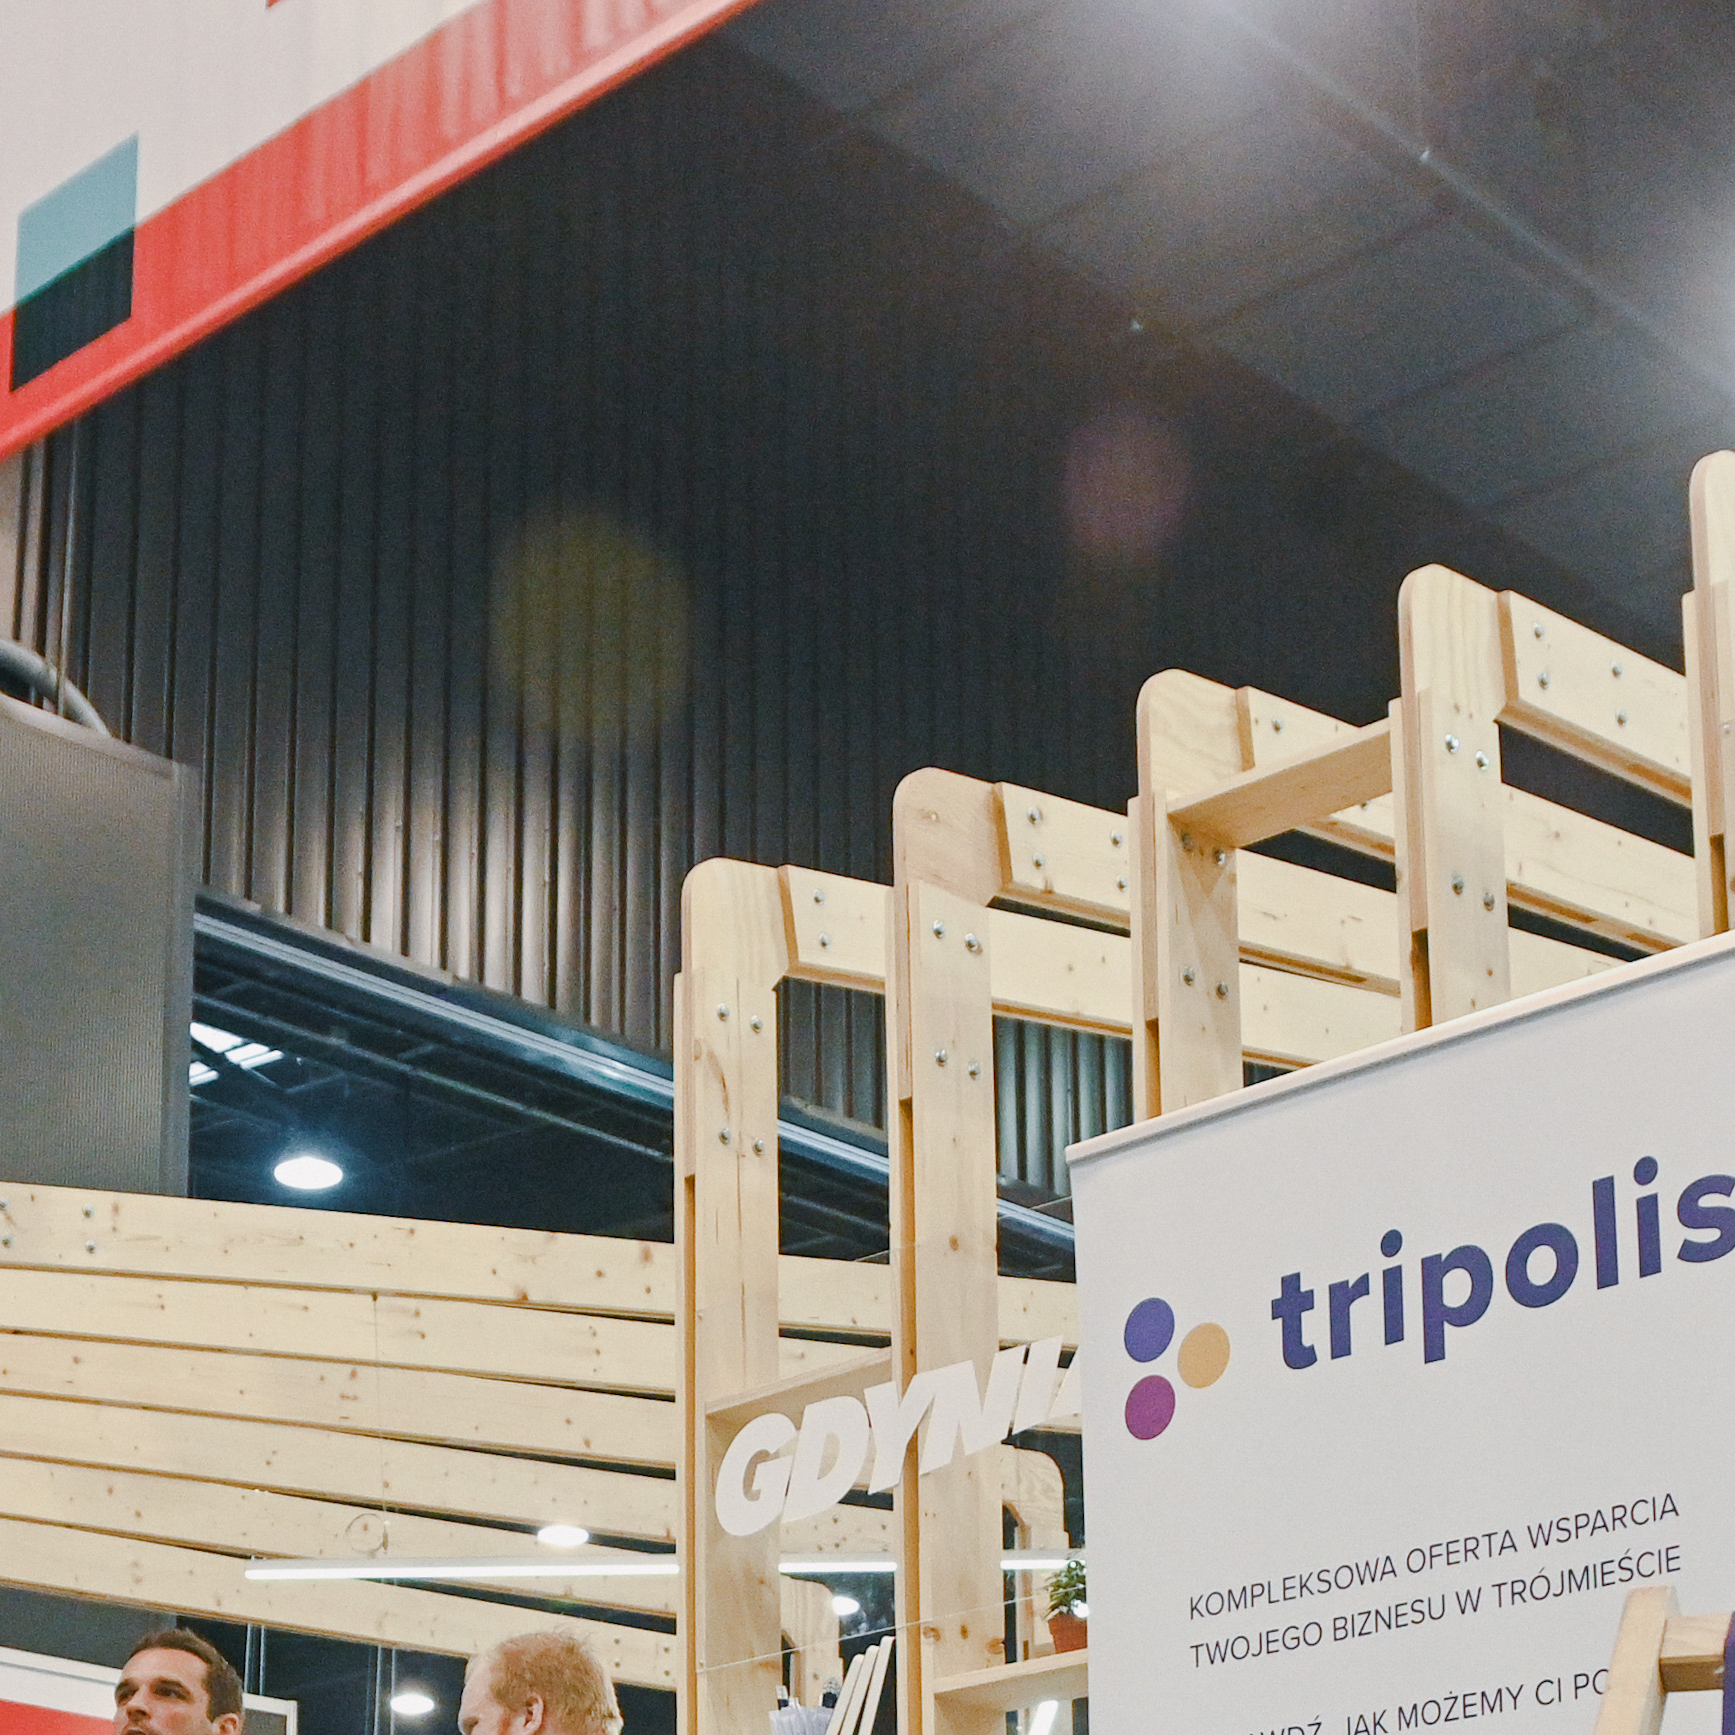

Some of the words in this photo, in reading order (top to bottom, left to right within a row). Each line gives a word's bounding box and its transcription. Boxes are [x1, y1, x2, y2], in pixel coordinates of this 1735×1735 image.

[1189, 1554, 1398, 1621] KOMPLEKSOWA
[1406, 1529, 1519, 1575] OFERTA
[1526, 1492, 1680, 1550] WSPARCIA
[1189, 1621, 1324, 1669] TWOJEGO
[1332, 1593, 1447, 1643] BIZNESU
[1455, 1588, 1483, 1616] W
[1492, 1545, 1683, 1609] TRÓJMIEŚCIE
[1397, 1683, 1524, 1731] MOŻEMY
[1535, 1676, 1564, 1707] CI
[1574, 1668, 1610, 1701] PO
